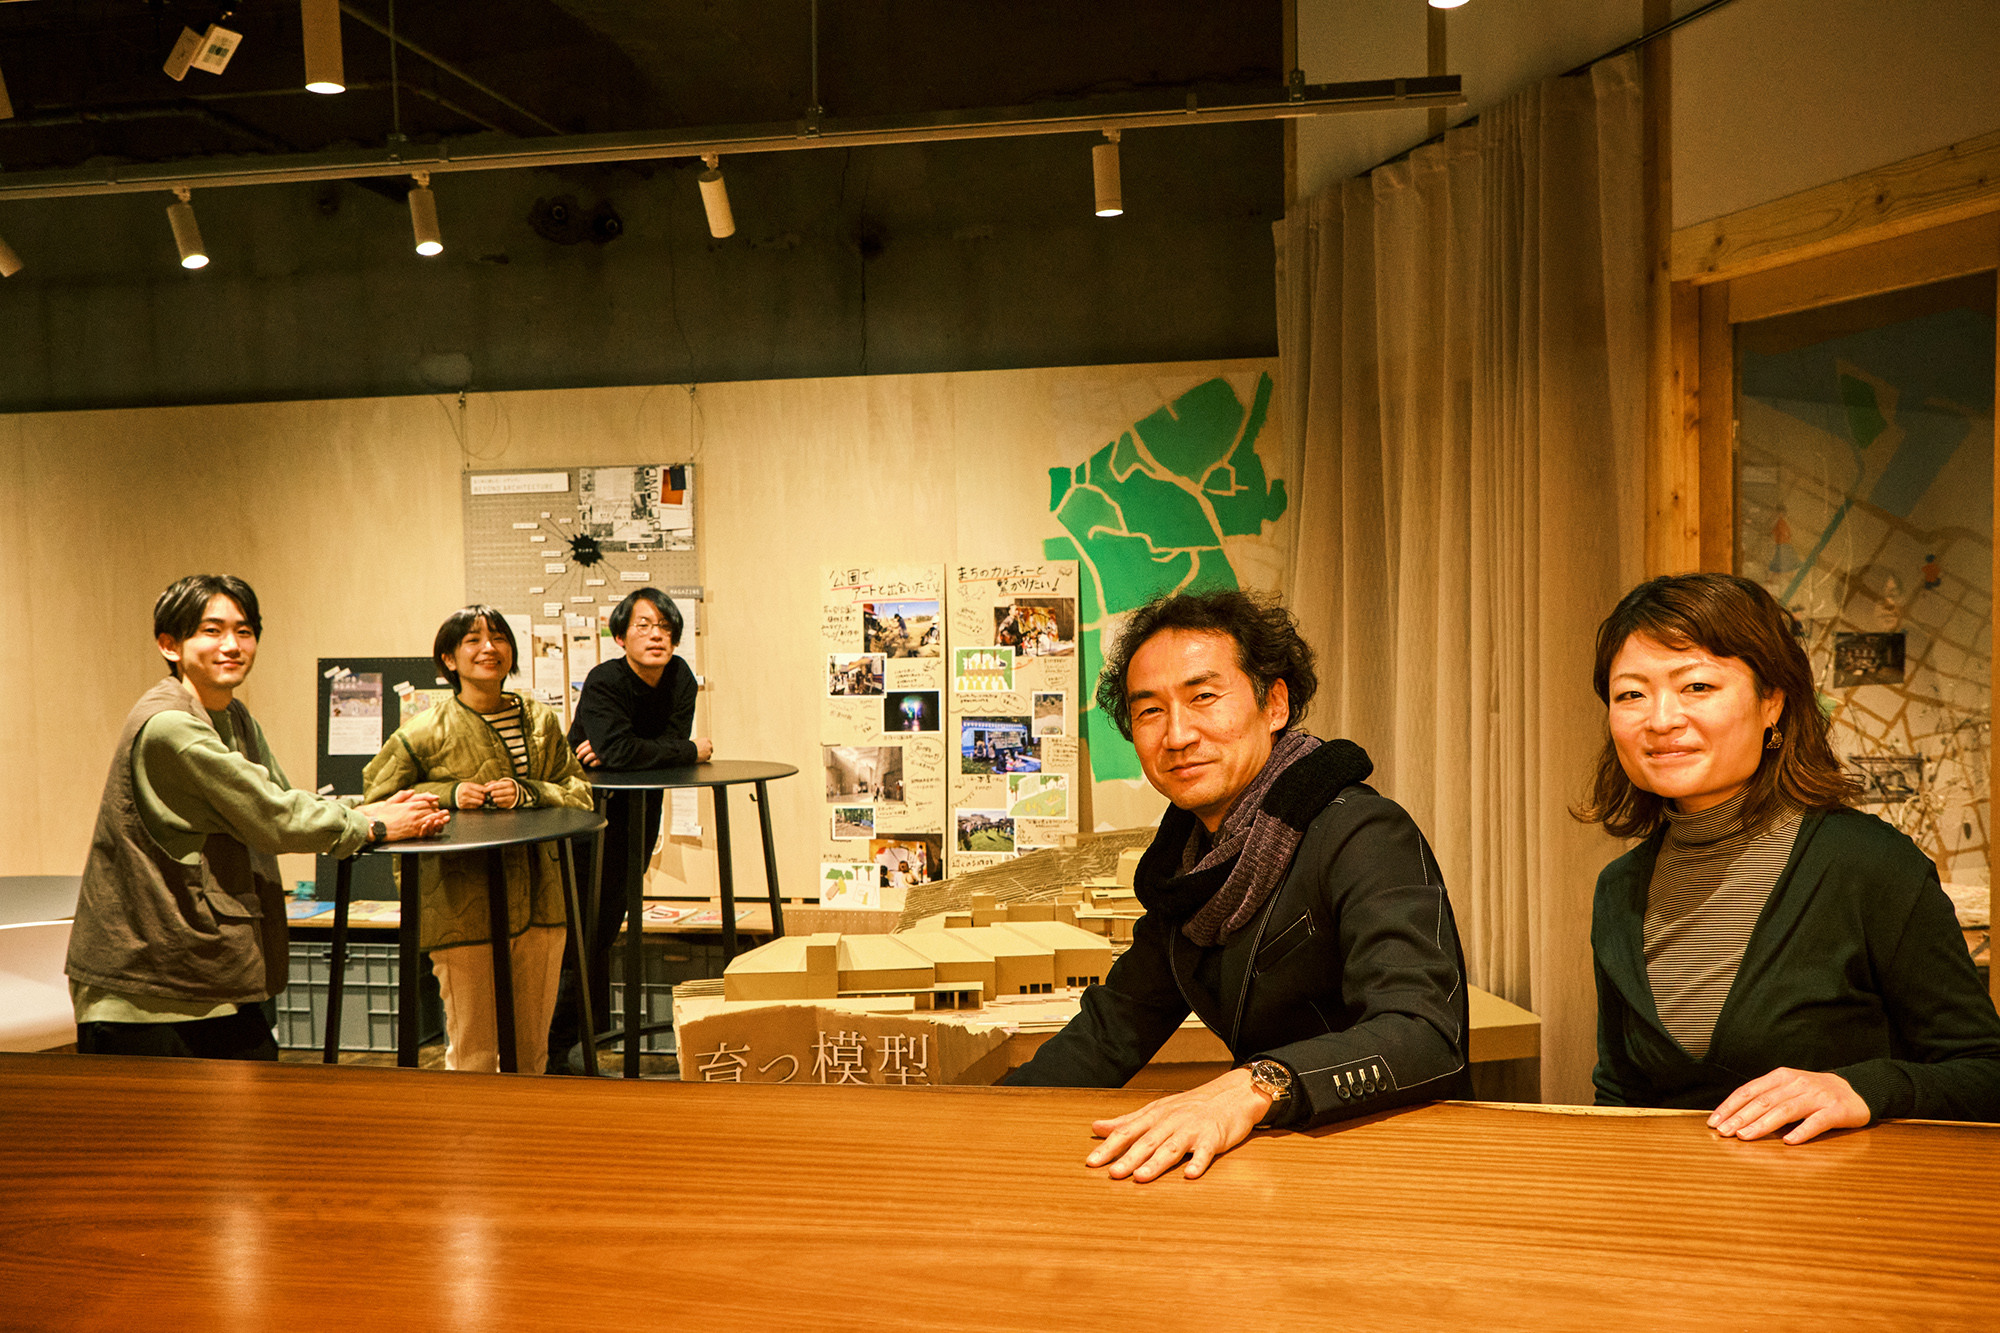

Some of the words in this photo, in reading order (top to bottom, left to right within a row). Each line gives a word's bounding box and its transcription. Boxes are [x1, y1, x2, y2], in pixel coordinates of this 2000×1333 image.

[829, 568, 874, 587] 公園で
[694, 1031, 931, 1085] 育つ模型
